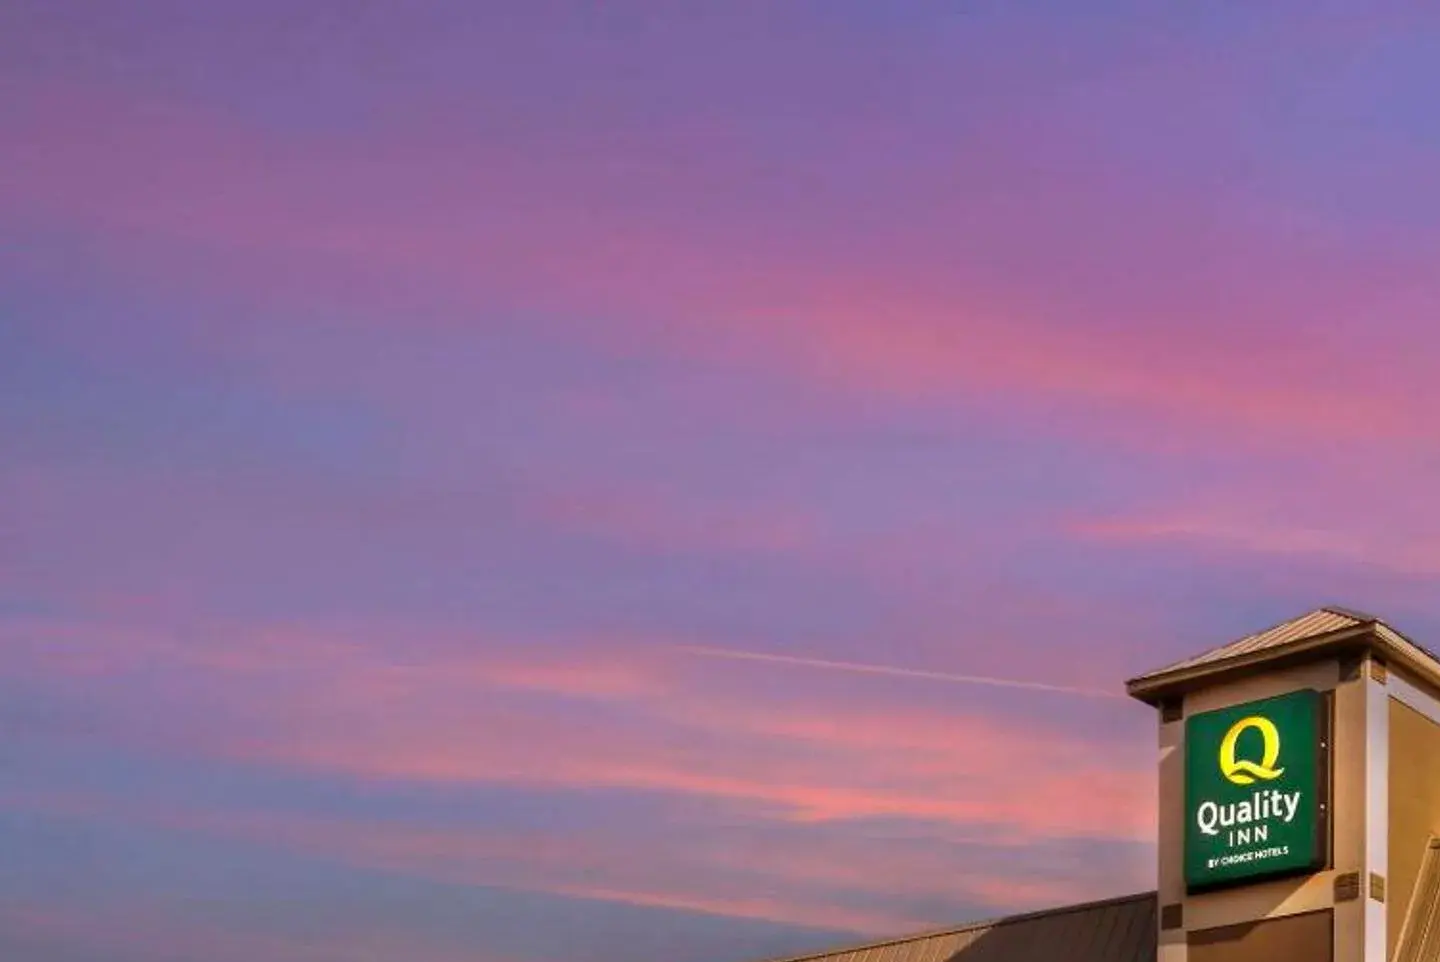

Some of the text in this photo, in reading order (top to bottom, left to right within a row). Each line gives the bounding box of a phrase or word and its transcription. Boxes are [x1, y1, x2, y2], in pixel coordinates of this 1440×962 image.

[1220, 715, 1284, 784] Q
[1197, 790, 1300, 835] Quality
[1229, 825, 1267, 847] INN
[1208, 846, 1289, 868] BY CHOICE HOTELS
